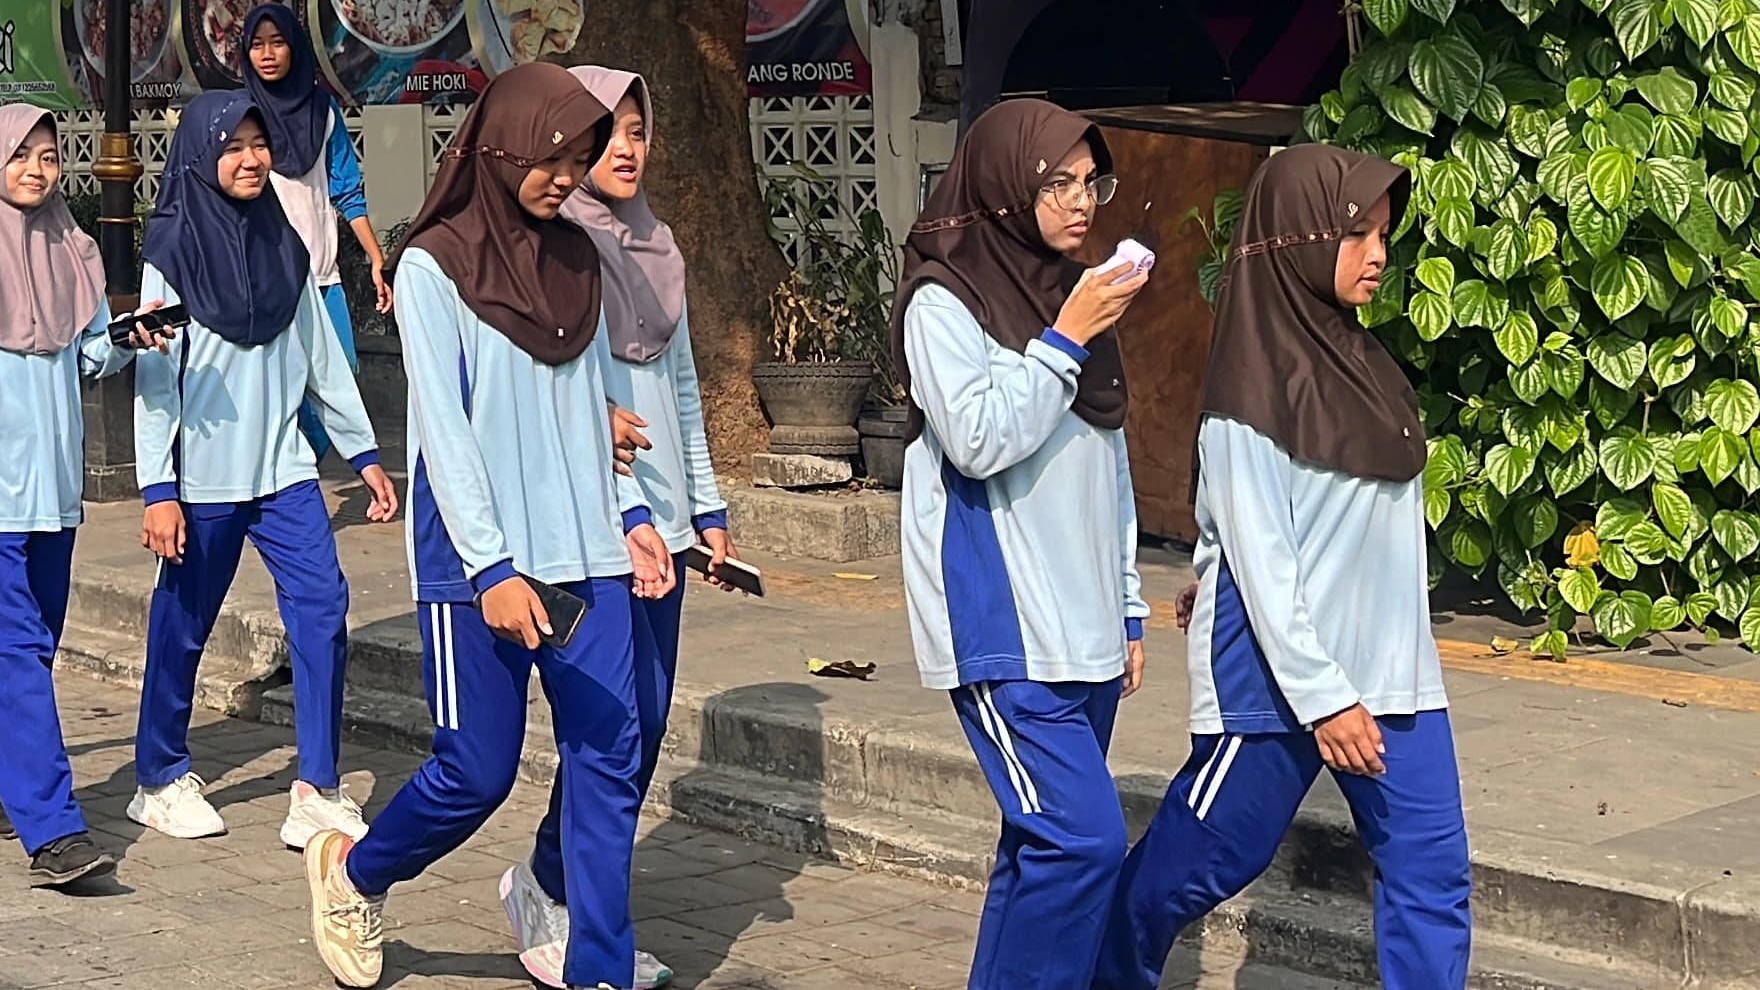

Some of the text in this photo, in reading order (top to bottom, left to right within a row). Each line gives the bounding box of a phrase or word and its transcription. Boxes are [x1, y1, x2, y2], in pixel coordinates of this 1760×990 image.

[747, 62, 854, 83] ANG RONDE
[135, 82, 181, 99] BAKMOY
[406, 73, 467, 91] MIE HOKI
